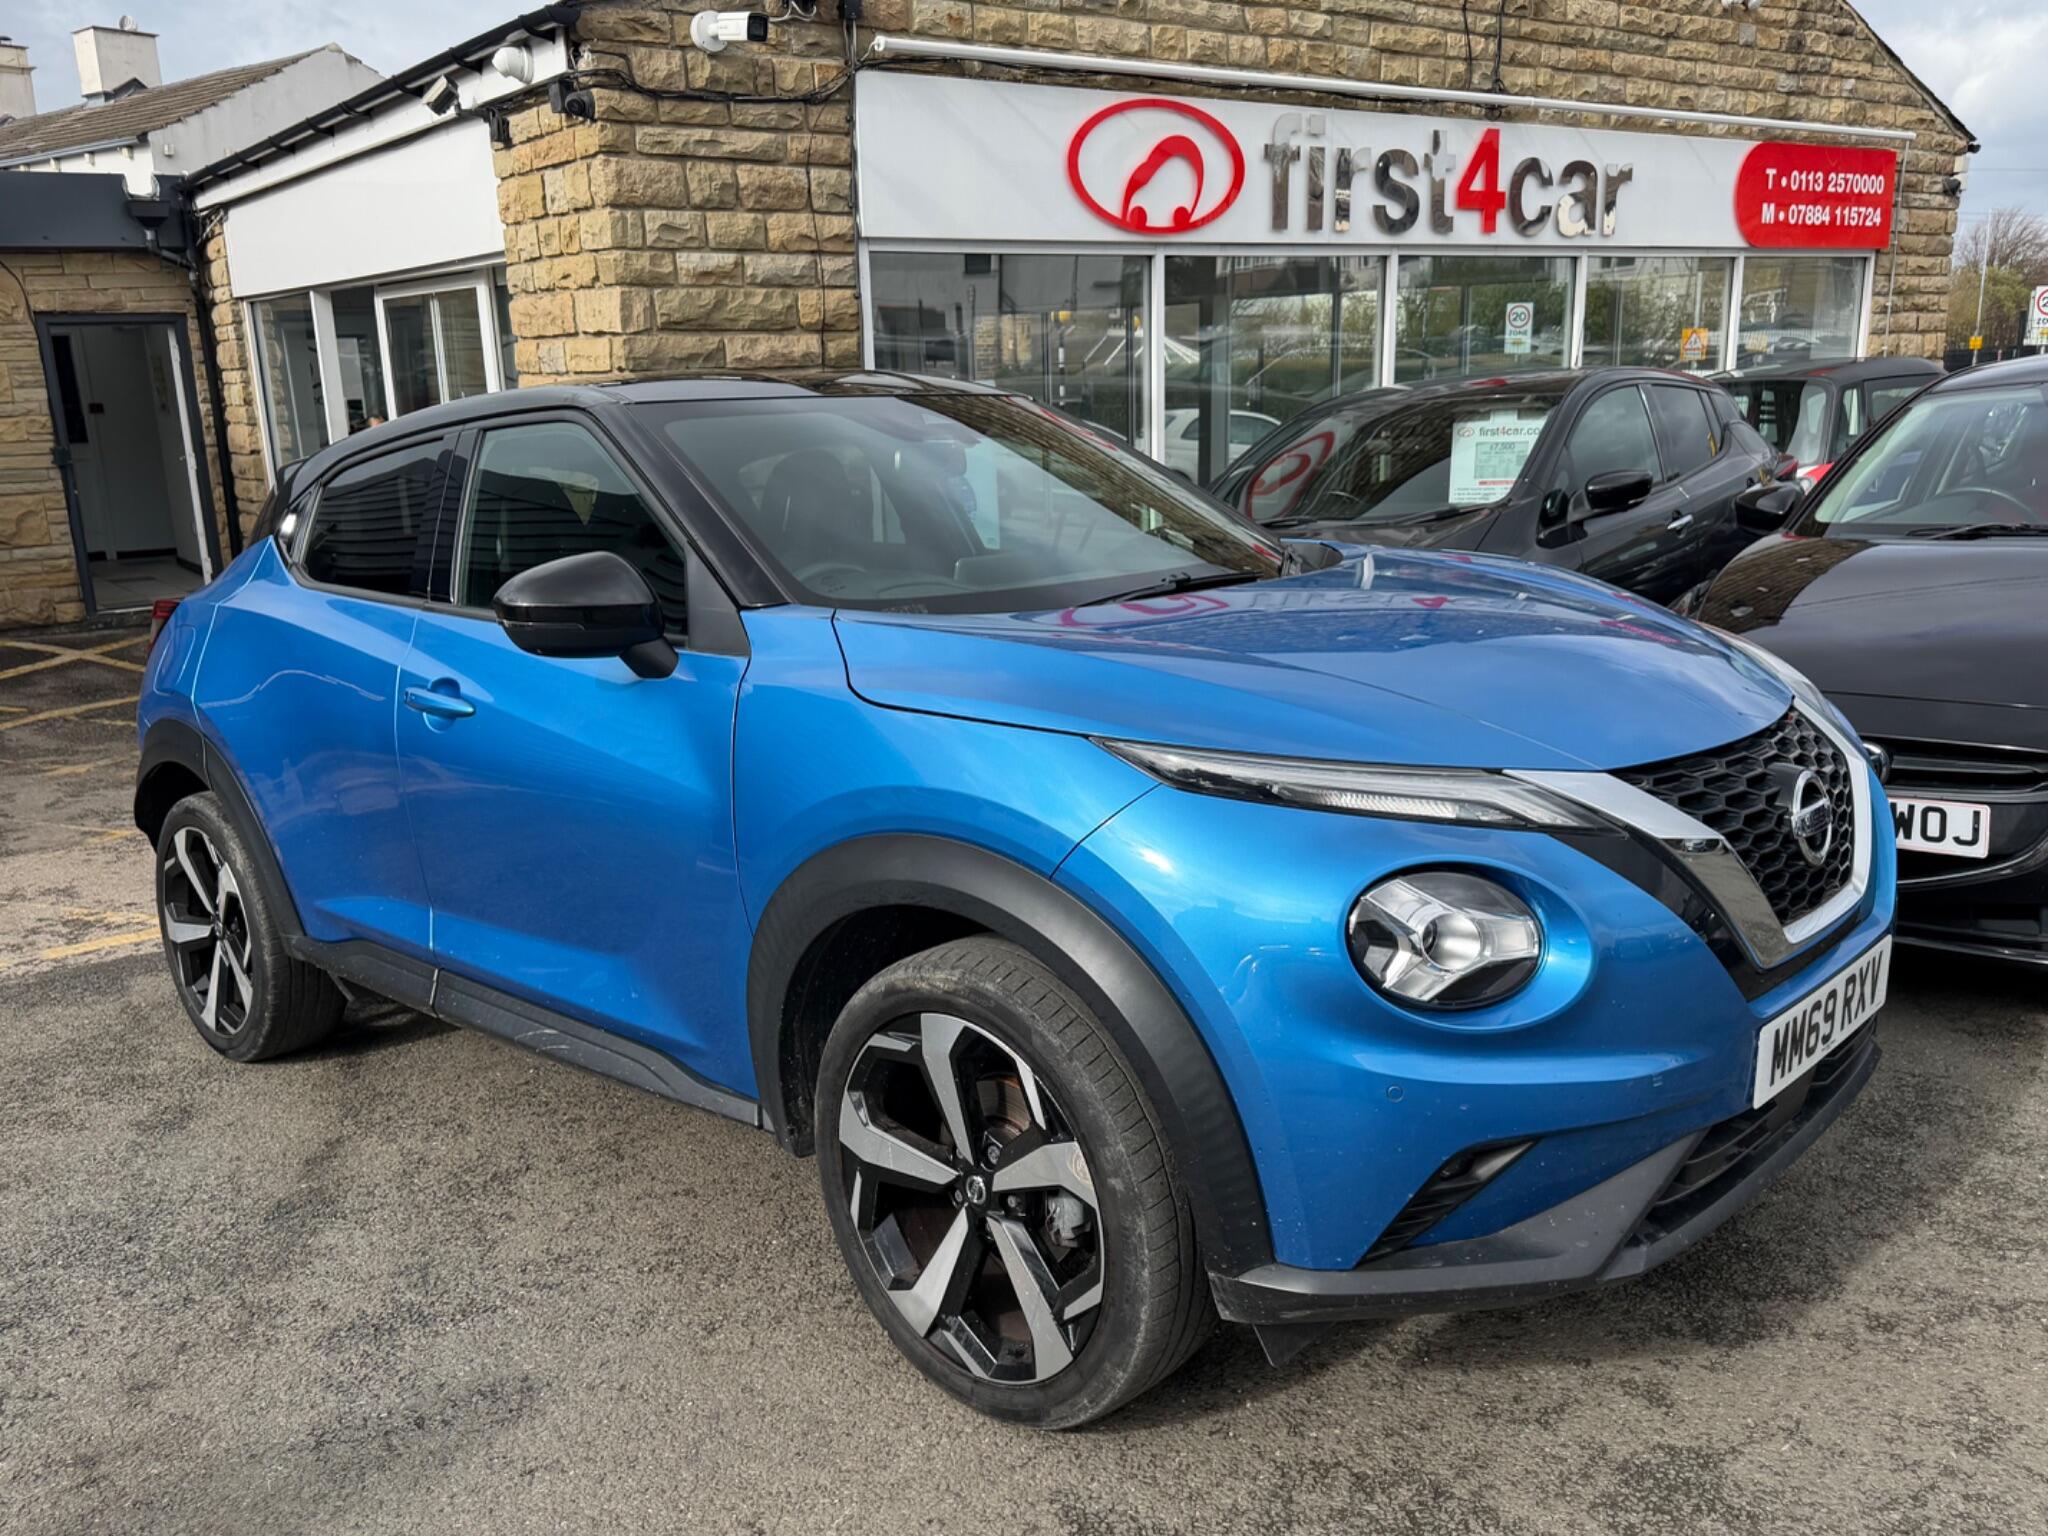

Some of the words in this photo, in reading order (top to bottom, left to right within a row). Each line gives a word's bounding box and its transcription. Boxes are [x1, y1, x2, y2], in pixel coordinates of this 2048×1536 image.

[1263, 111, 1633, 237] first4car
[1765, 168, 1777, 191] T
[1790, 170, 1824, 192] 0113
[1827, 172, 1885, 195] 2570000
[1761, 202, 1775, 225] M
[1788, 204, 1830, 226] 07884
[1835, 206, 1882, 227] 115724
[1511, 311, 1527, 322] 20
[1479, 426, 1540, 437] first4car.co
[1889, 801, 1982, 847] WOJ
[1769, 988, 1838, 1088] MM69
[1840, 949, 1884, 1032] RXV
